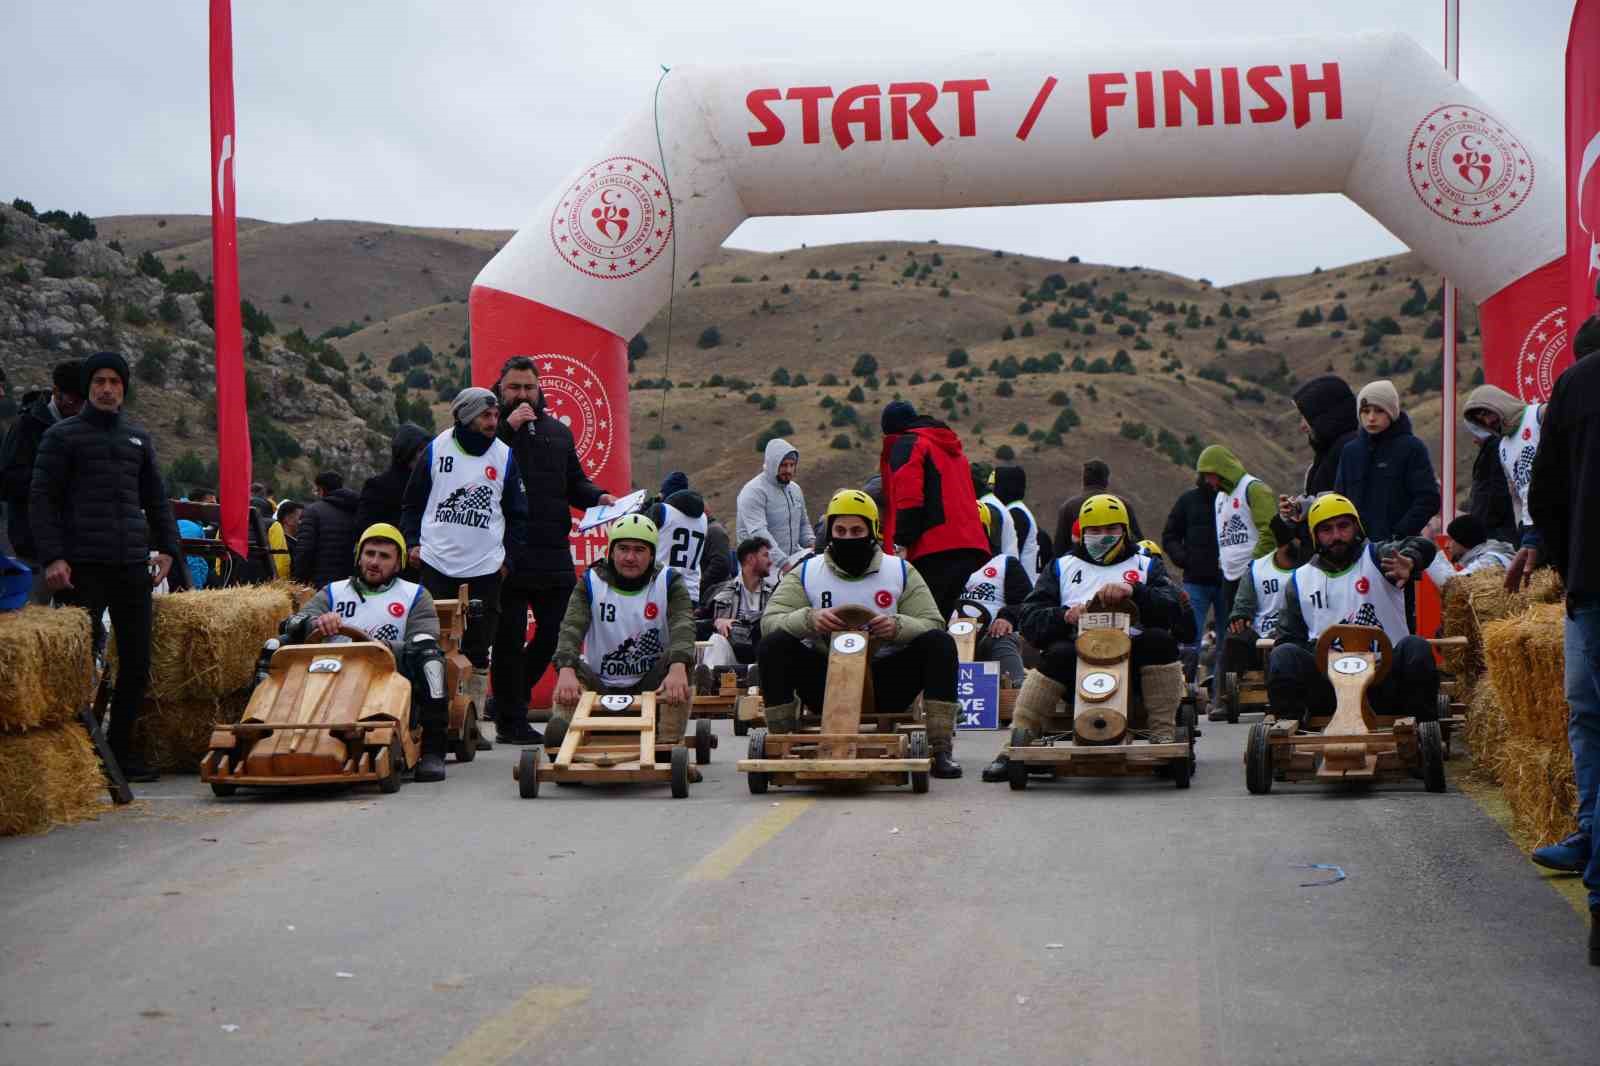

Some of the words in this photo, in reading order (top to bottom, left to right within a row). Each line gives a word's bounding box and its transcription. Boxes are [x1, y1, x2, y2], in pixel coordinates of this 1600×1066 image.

[746, 78, 990, 151] START
[1015, 75, 1058, 141] /
[1088, 62, 1343, 139] FINISH
[439, 456, 453, 473] 18
[570, 540, 608, 566] LİK
[669, 527, 705, 570] 27
[1072, 569, 1083, 584] 4
[1262, 578, 1279, 595] 30
[821, 590, 833, 609] 8
[336, 601, 356, 617] 20
[599, 602, 616, 622] 13
[843, 638, 856, 648] 8
[1093, 678, 1105, 689] 4
[607, 695, 628, 704] 13
